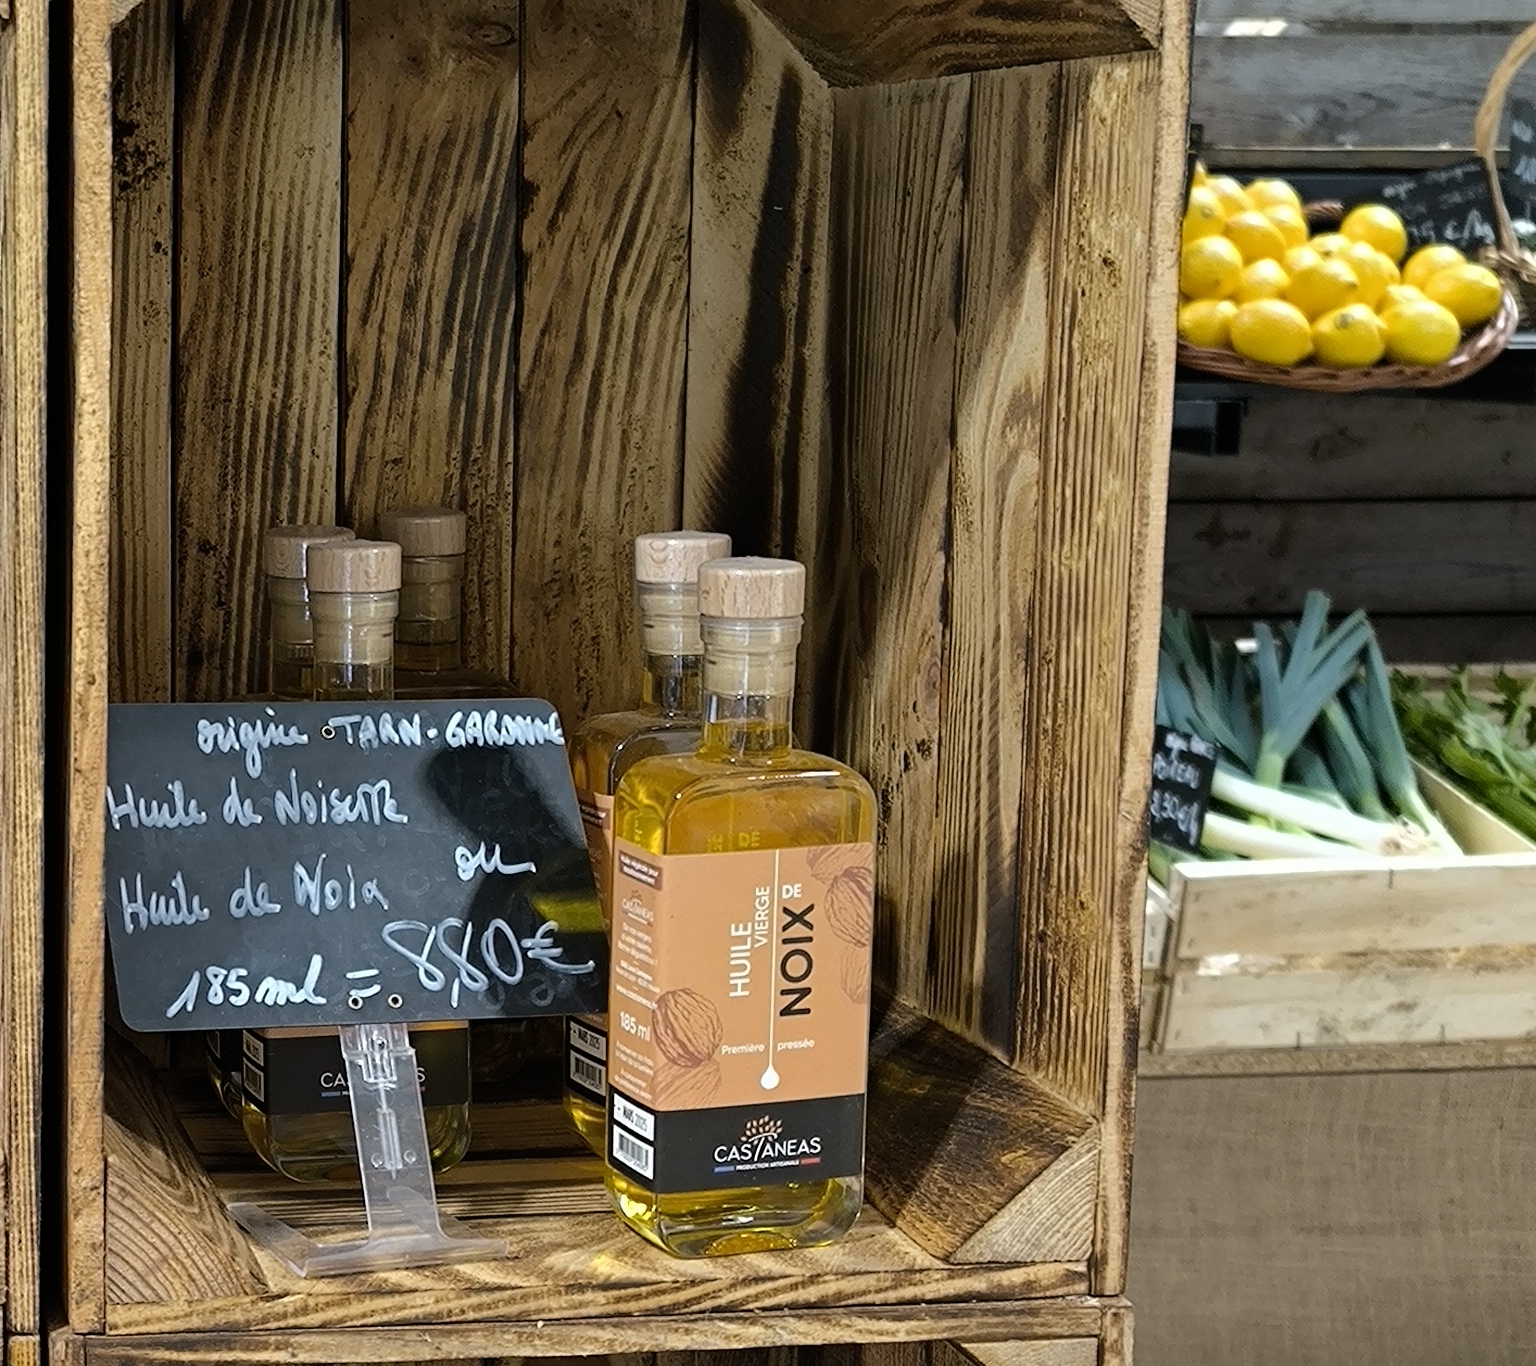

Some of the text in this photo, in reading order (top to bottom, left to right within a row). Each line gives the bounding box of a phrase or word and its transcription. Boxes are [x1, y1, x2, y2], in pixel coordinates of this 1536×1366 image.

[106, 780, 207, 831] Huile
[222, 776, 262, 827] de
[455, 841, 536, 881] ou
[120, 870, 211, 934] Huile
[229, 866, 281, 919] de
[754, 883, 802, 949] VIERGE DE
[729, 921, 752, 998] HUILE
[779, 903, 815, 1018] NOIX
[619, 1011, 652, 1042] 185 ml
[721, 1038, 815, 1055] Première pressée
[713, 1133, 822, 1163] CASTANEAS
